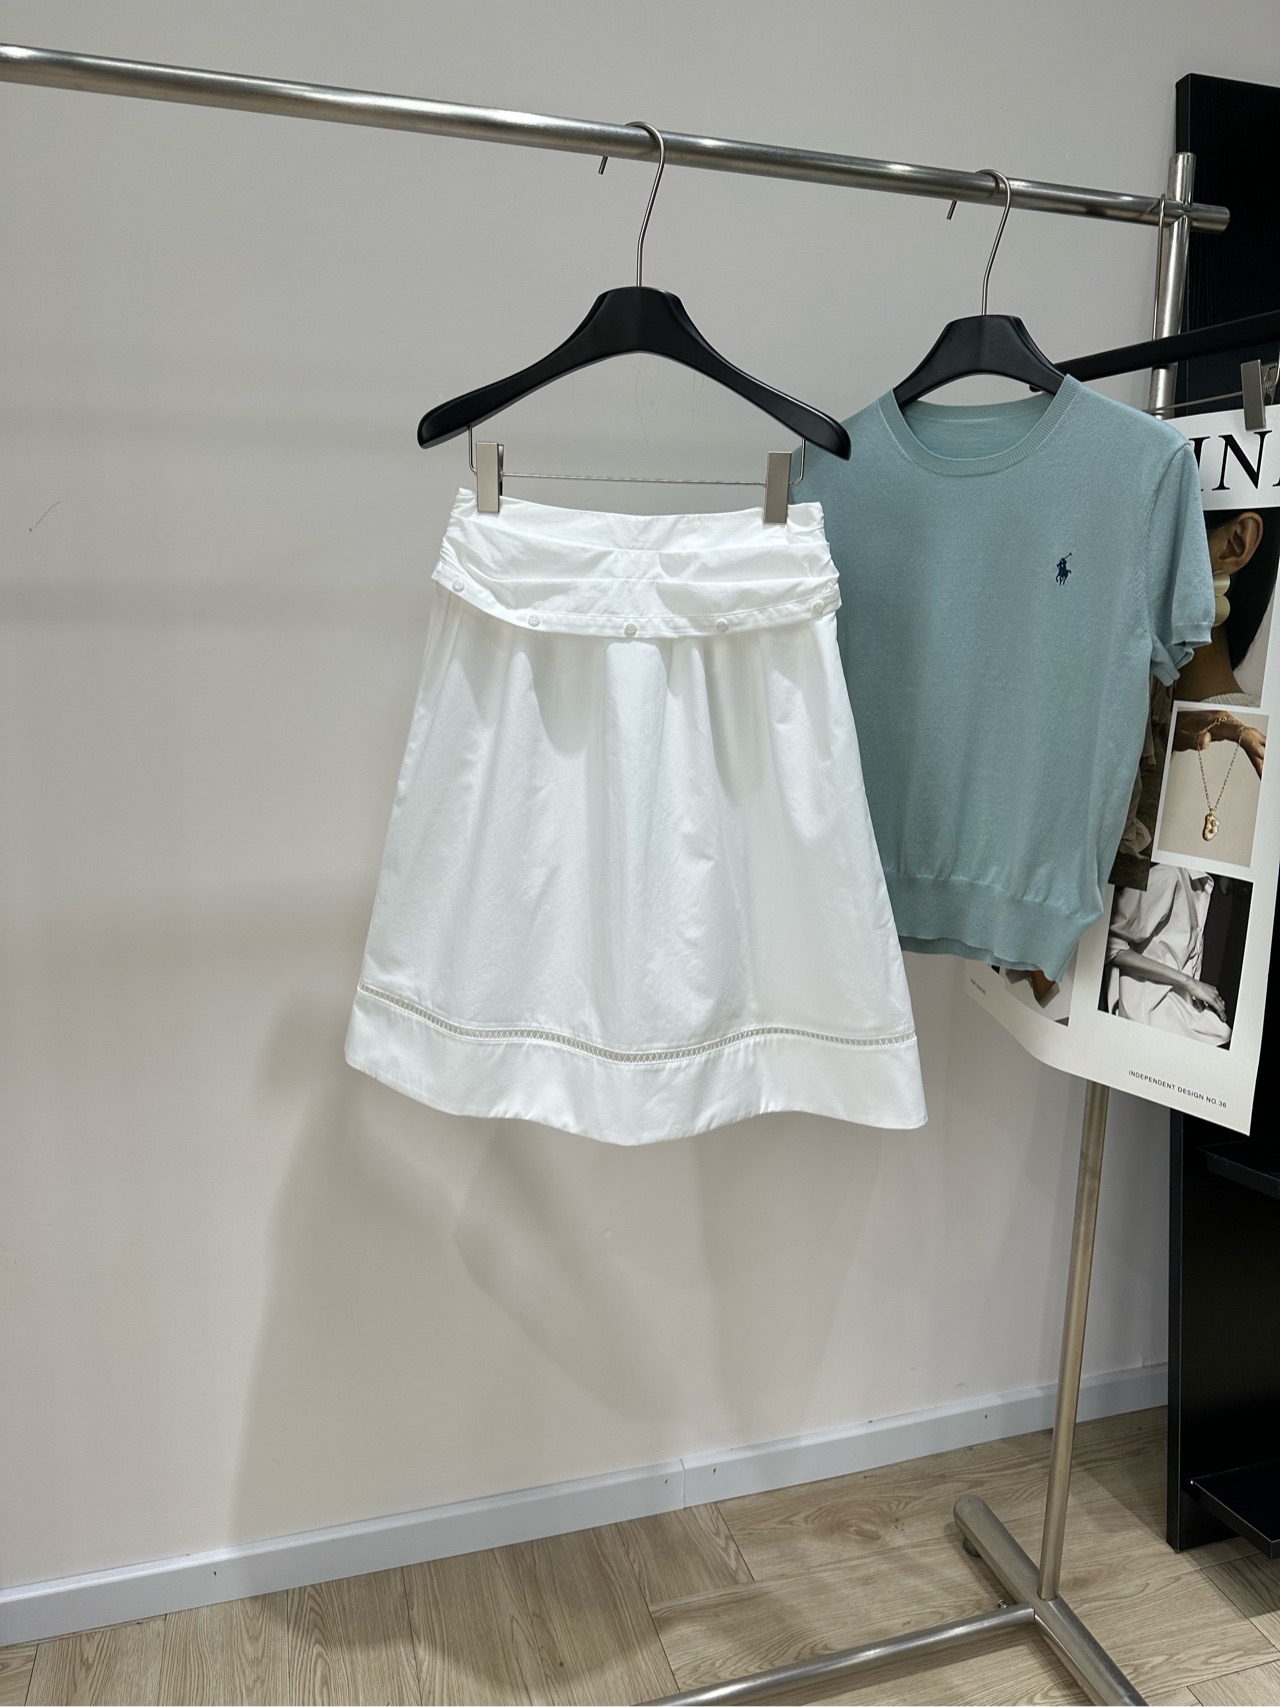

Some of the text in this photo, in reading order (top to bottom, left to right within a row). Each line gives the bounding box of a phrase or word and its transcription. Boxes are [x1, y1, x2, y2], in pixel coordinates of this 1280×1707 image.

[1128, 1069, 1228, 1109] INDEPENDENT DESIGN NO.36
